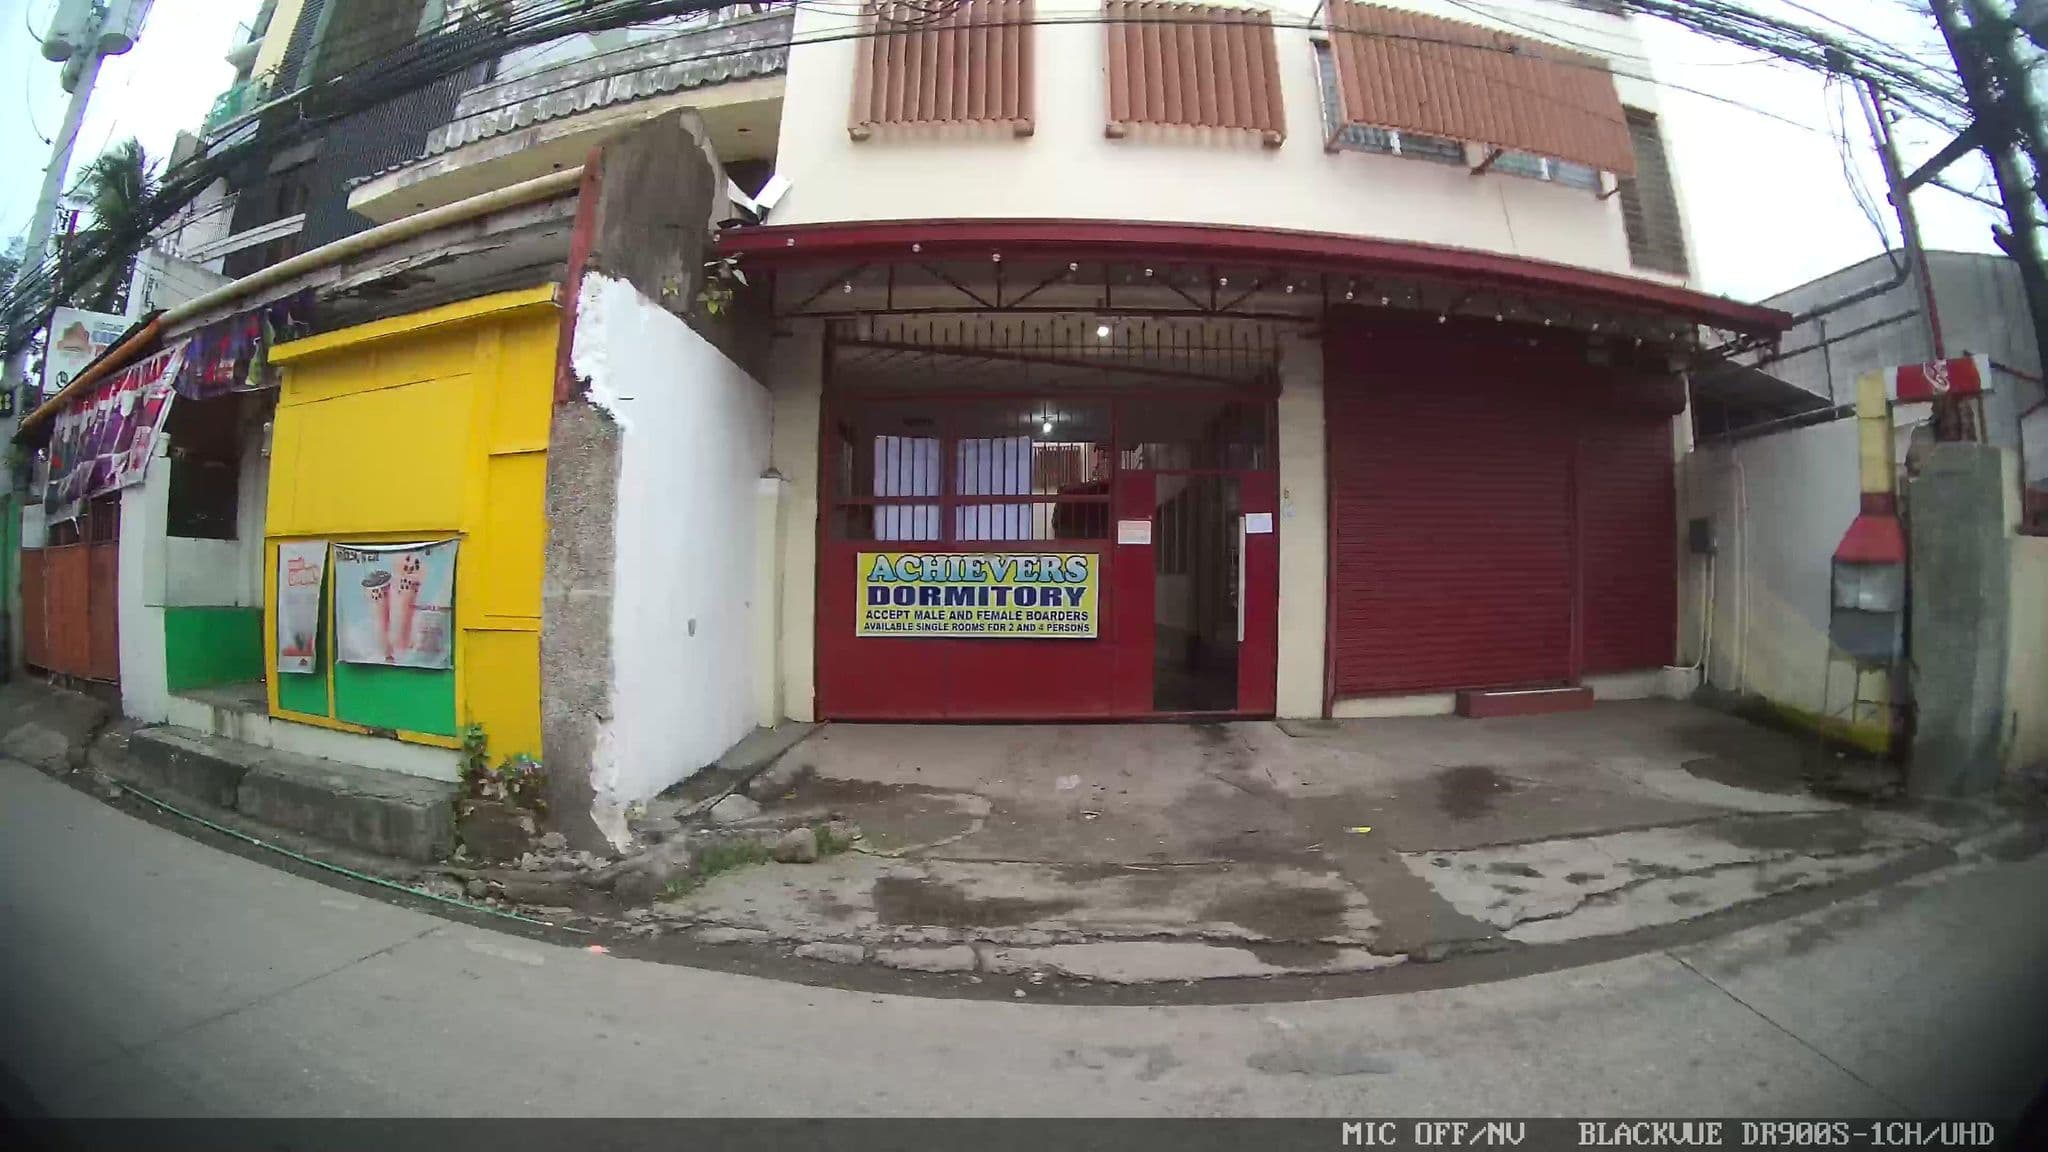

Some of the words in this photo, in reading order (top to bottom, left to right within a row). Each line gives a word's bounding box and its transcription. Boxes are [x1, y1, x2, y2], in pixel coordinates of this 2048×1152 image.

[867, 554, 1088, 583] ACHIEVERS
[868, 585, 1086, 607] DORMITORY
[866, 610, 910, 620] ACCEPT
[914, 610, 945, 620] MALE
[949, 610, 973, 620] AND
[976, 610, 1023, 620] FEMALE
[1026, 611, 1089, 620] BOARDERS
[864, 623, 913, 631] AVAILABLE
[916, 623, 948, 631] SINGLE
[951, 623, 985, 632] ROOMS
[988, 623, 1006, 632] FOR
[1009, 623, 1014, 632] 2
[1017, 623, 1036, 632] AND
[1047, 623, 1090, 632] PERSONS
